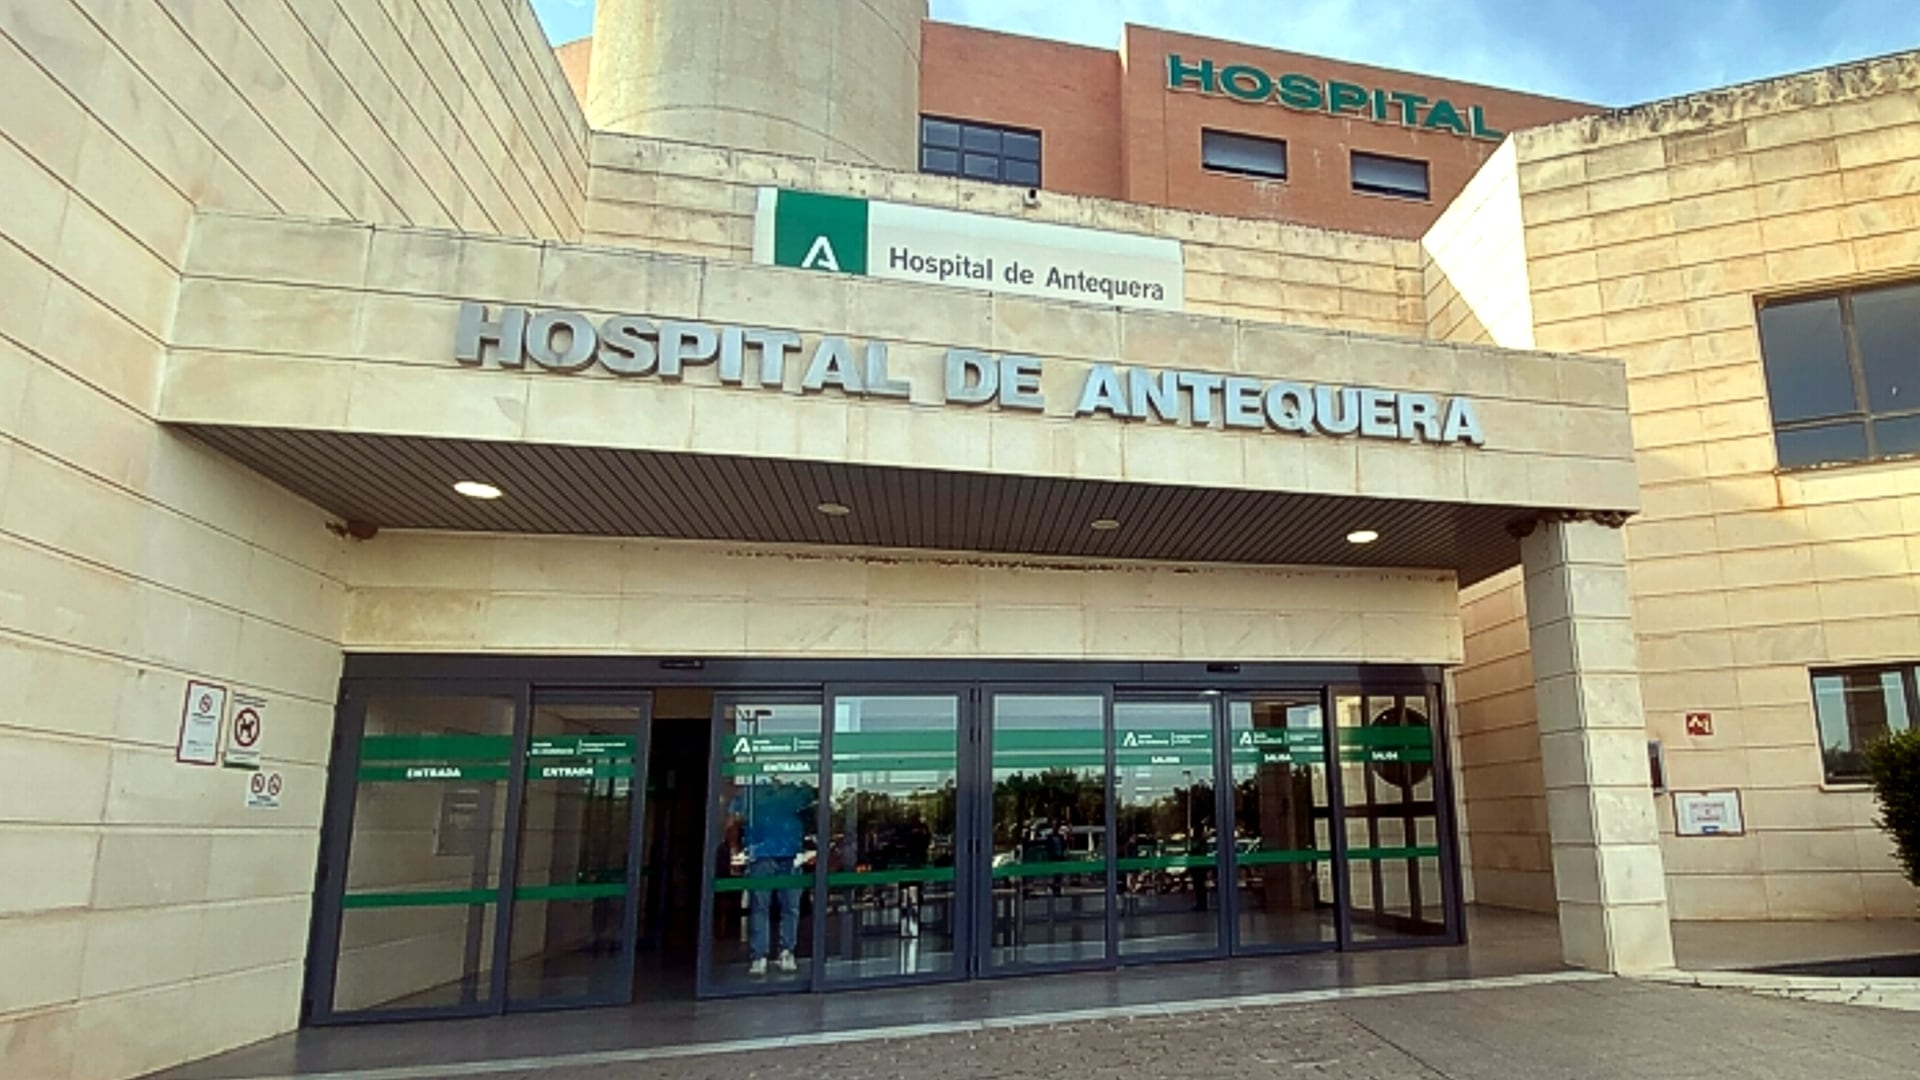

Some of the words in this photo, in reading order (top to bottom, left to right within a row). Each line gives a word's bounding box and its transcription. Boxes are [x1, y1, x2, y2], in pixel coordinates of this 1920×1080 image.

[1166, 53, 1506, 142] HOSPITAL
[889, 246, 994, 281] Hospital
[1004, 260, 1034, 285] de
[1044, 266, 1165, 301] Antequera
[455, 301, 910, 400] HOSPITAL
[944, 347, 1044, 412] DE
[1075, 362, 1485, 445] ANTEQUERA
